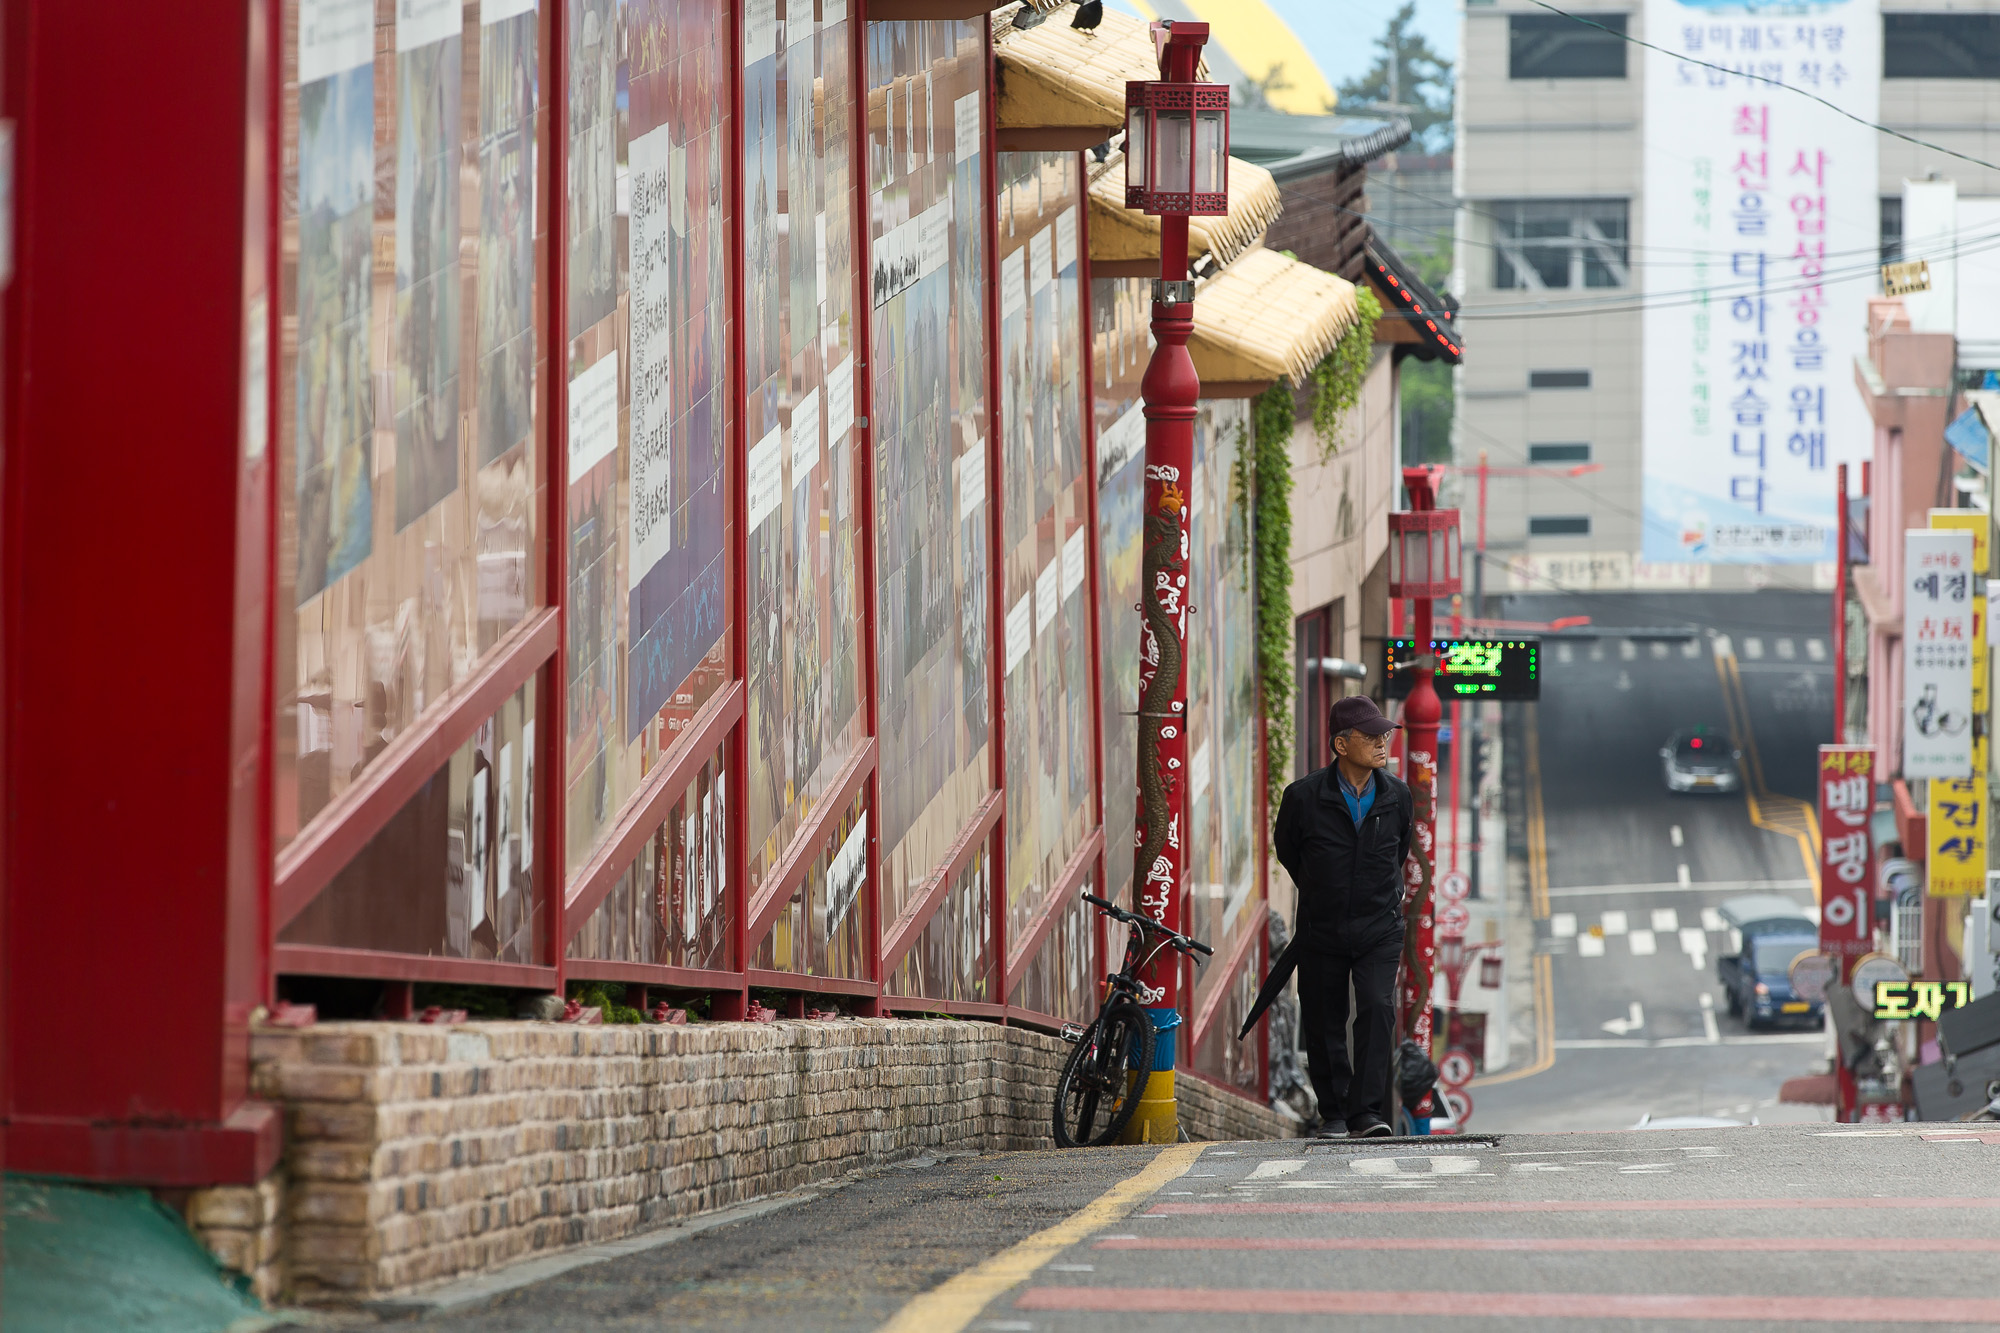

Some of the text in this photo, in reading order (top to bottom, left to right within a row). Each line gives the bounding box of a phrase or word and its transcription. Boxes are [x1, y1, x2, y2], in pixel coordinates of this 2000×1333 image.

[1731, 105, 1770, 514] 최선을 다하겠습니다
[1788, 150, 1829, 470] 사업성공을 위해
[1825, 774, 1869, 939] 밴댕이
